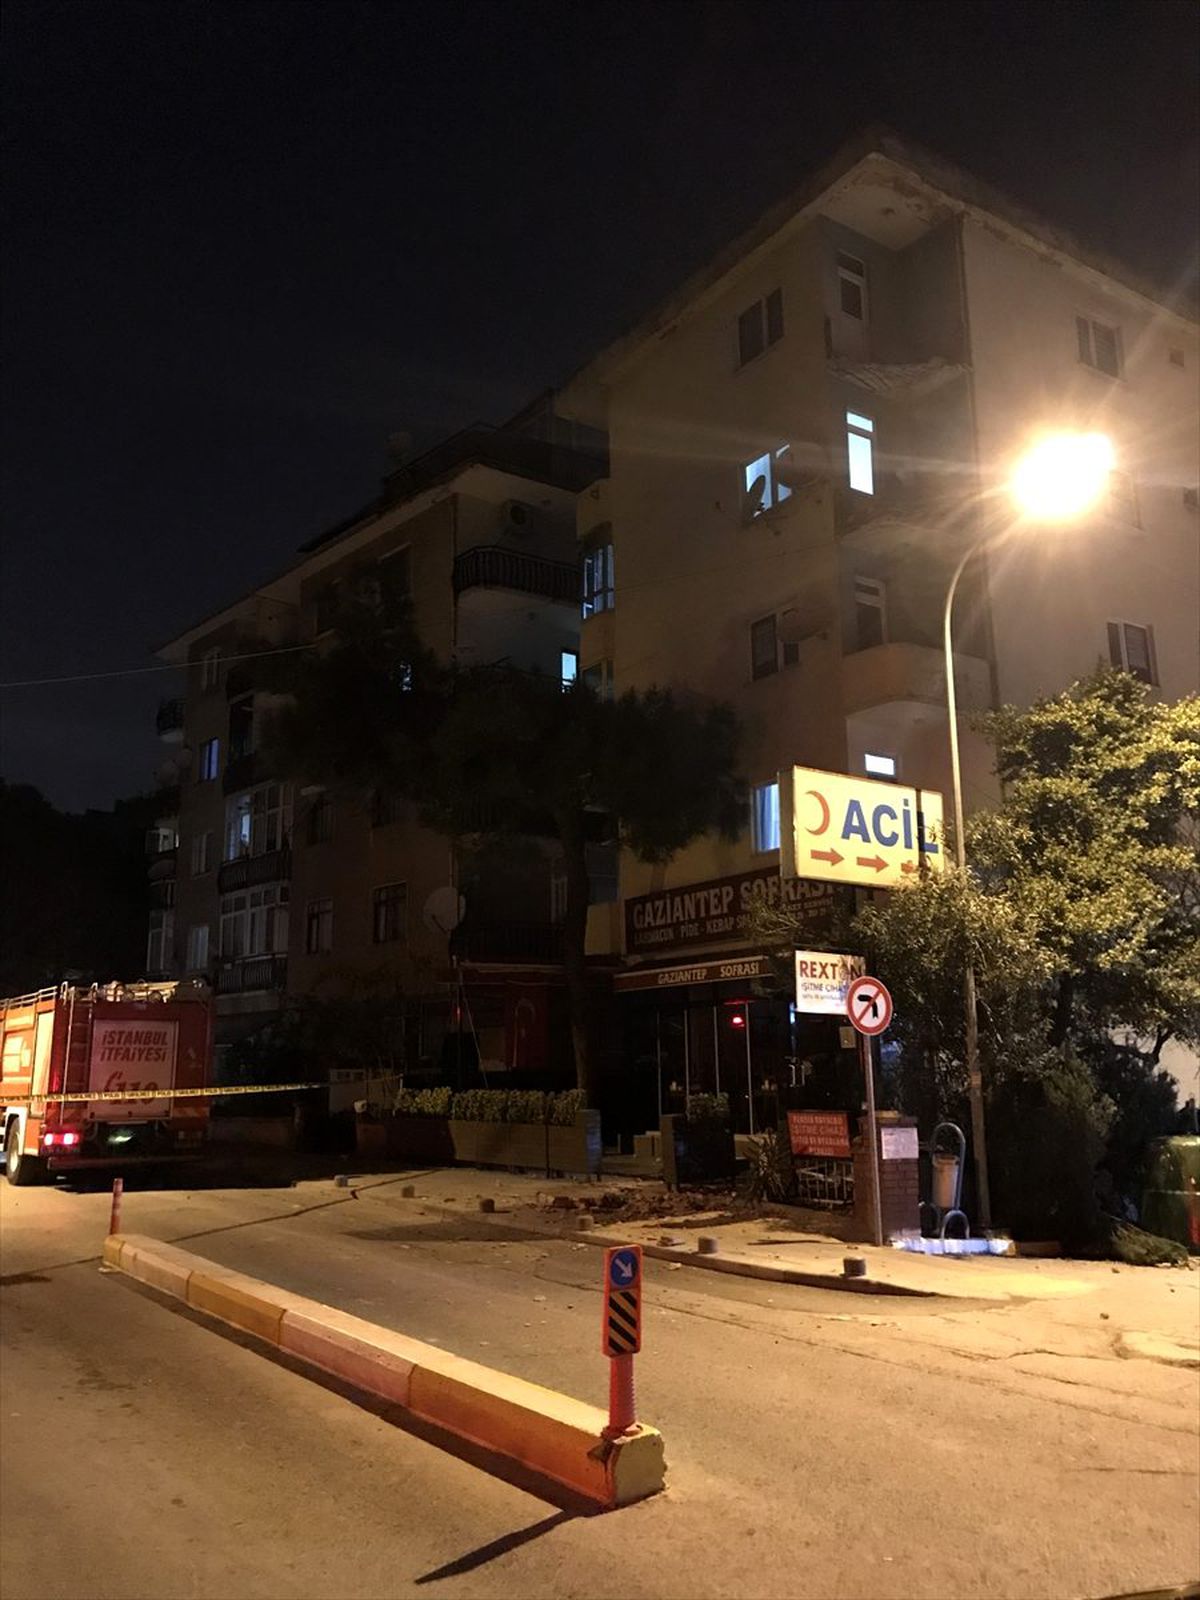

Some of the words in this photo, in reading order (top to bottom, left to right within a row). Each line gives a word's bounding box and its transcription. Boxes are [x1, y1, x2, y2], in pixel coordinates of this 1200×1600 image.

[841, 798, 939, 854] ACİL
[633, 885, 734, 929] GAZİANTEP
[719, 961, 760, 978] SOFRASI
[102, 1029, 168, 1046] İSTANBUL
[100, 1046, 167, 1062] İTFAİYESİ
